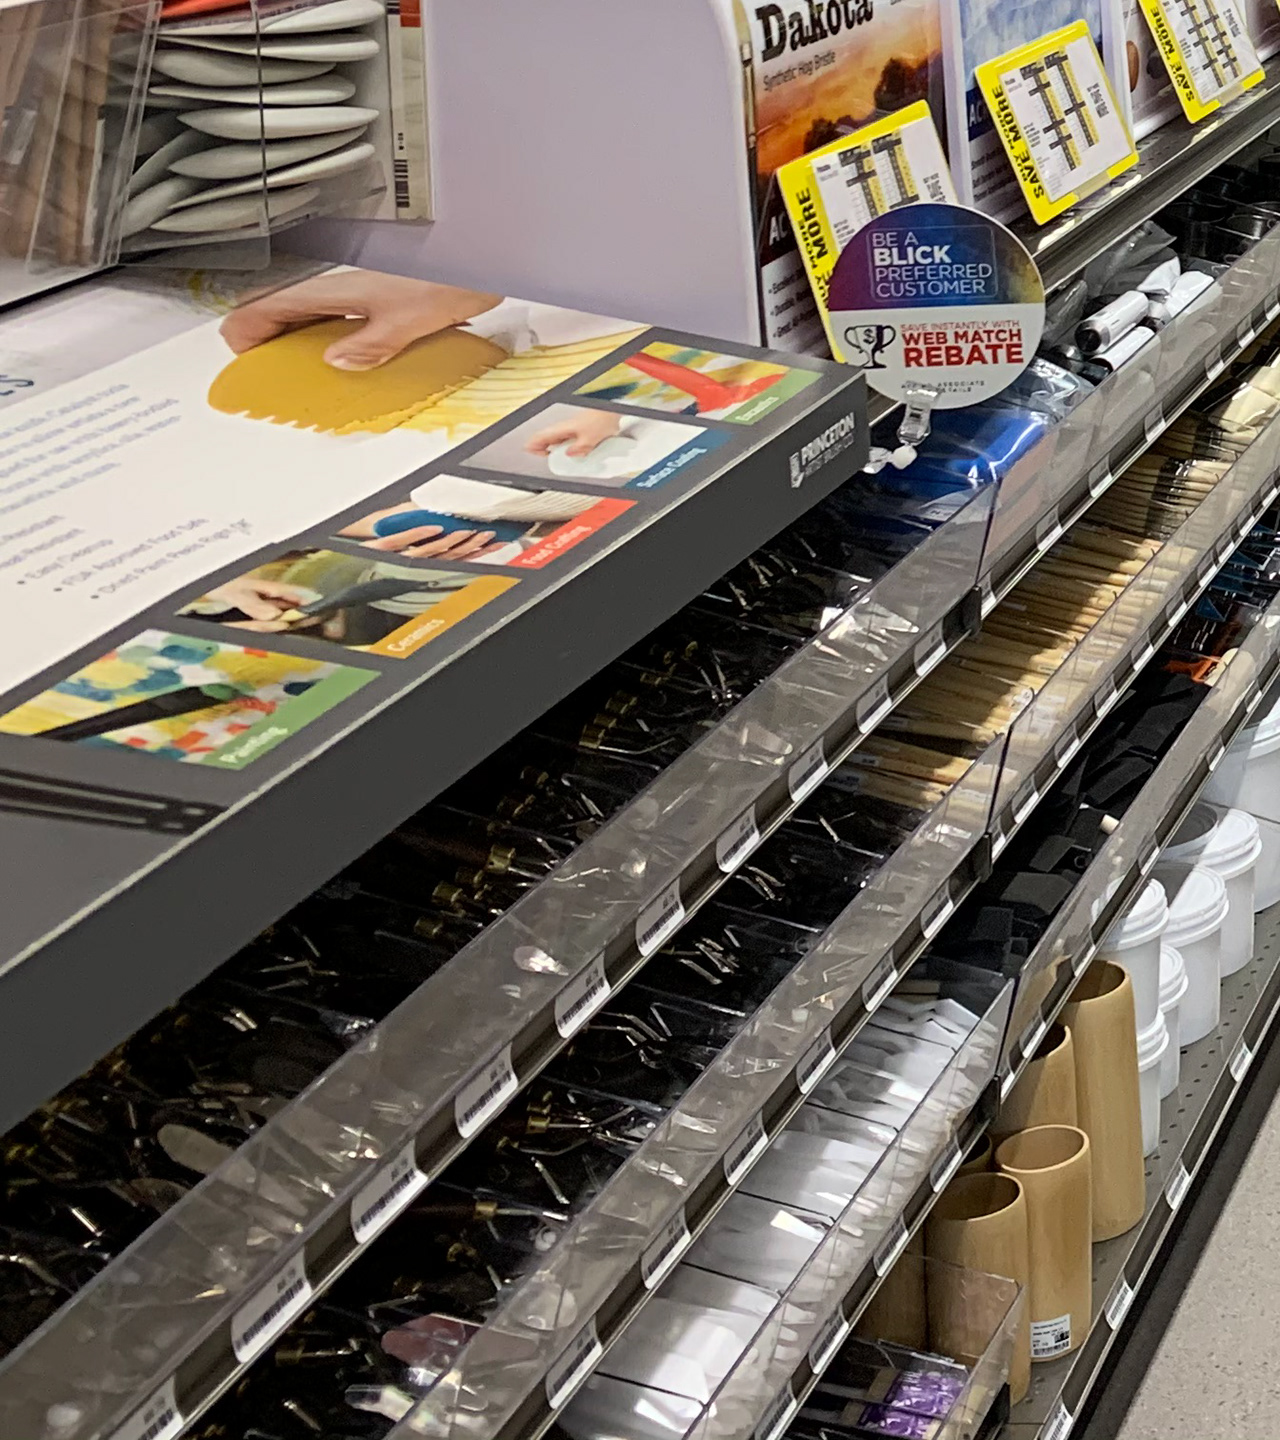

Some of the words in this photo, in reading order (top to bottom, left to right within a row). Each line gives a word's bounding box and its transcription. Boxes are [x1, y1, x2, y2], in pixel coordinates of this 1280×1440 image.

[1149, 6, 1176, 56] MORE
[763, 65, 797, 93] Synthetic
[1171, 61, 1196, 103] SAVE
[992, 82, 1022, 143] MORE
[1021, 148, 1045, 200] SAVE
[796, 186, 830, 261] MORE
[872, 232, 898, 247] BE
[904, 231, 919, 246] A
[873, 244, 953, 266] BLICK
[875, 263, 993, 281] PREFERRED
[876, 279, 986, 298] CUSTOMER
[900, 322, 928, 332] SAVE
[930, 320, 988, 332] INSTANTLY
[991, 319, 1020, 328] WITH
[902, 331, 948, 346] WEB
[954, 328, 1022, 344] MATCH
[903, 343, 1024, 368] REBATE
[800, 411, 856, 466] PRINCETON
[520, 546, 547, 566] Food
[387, 617, 446, 652] Ceramics
